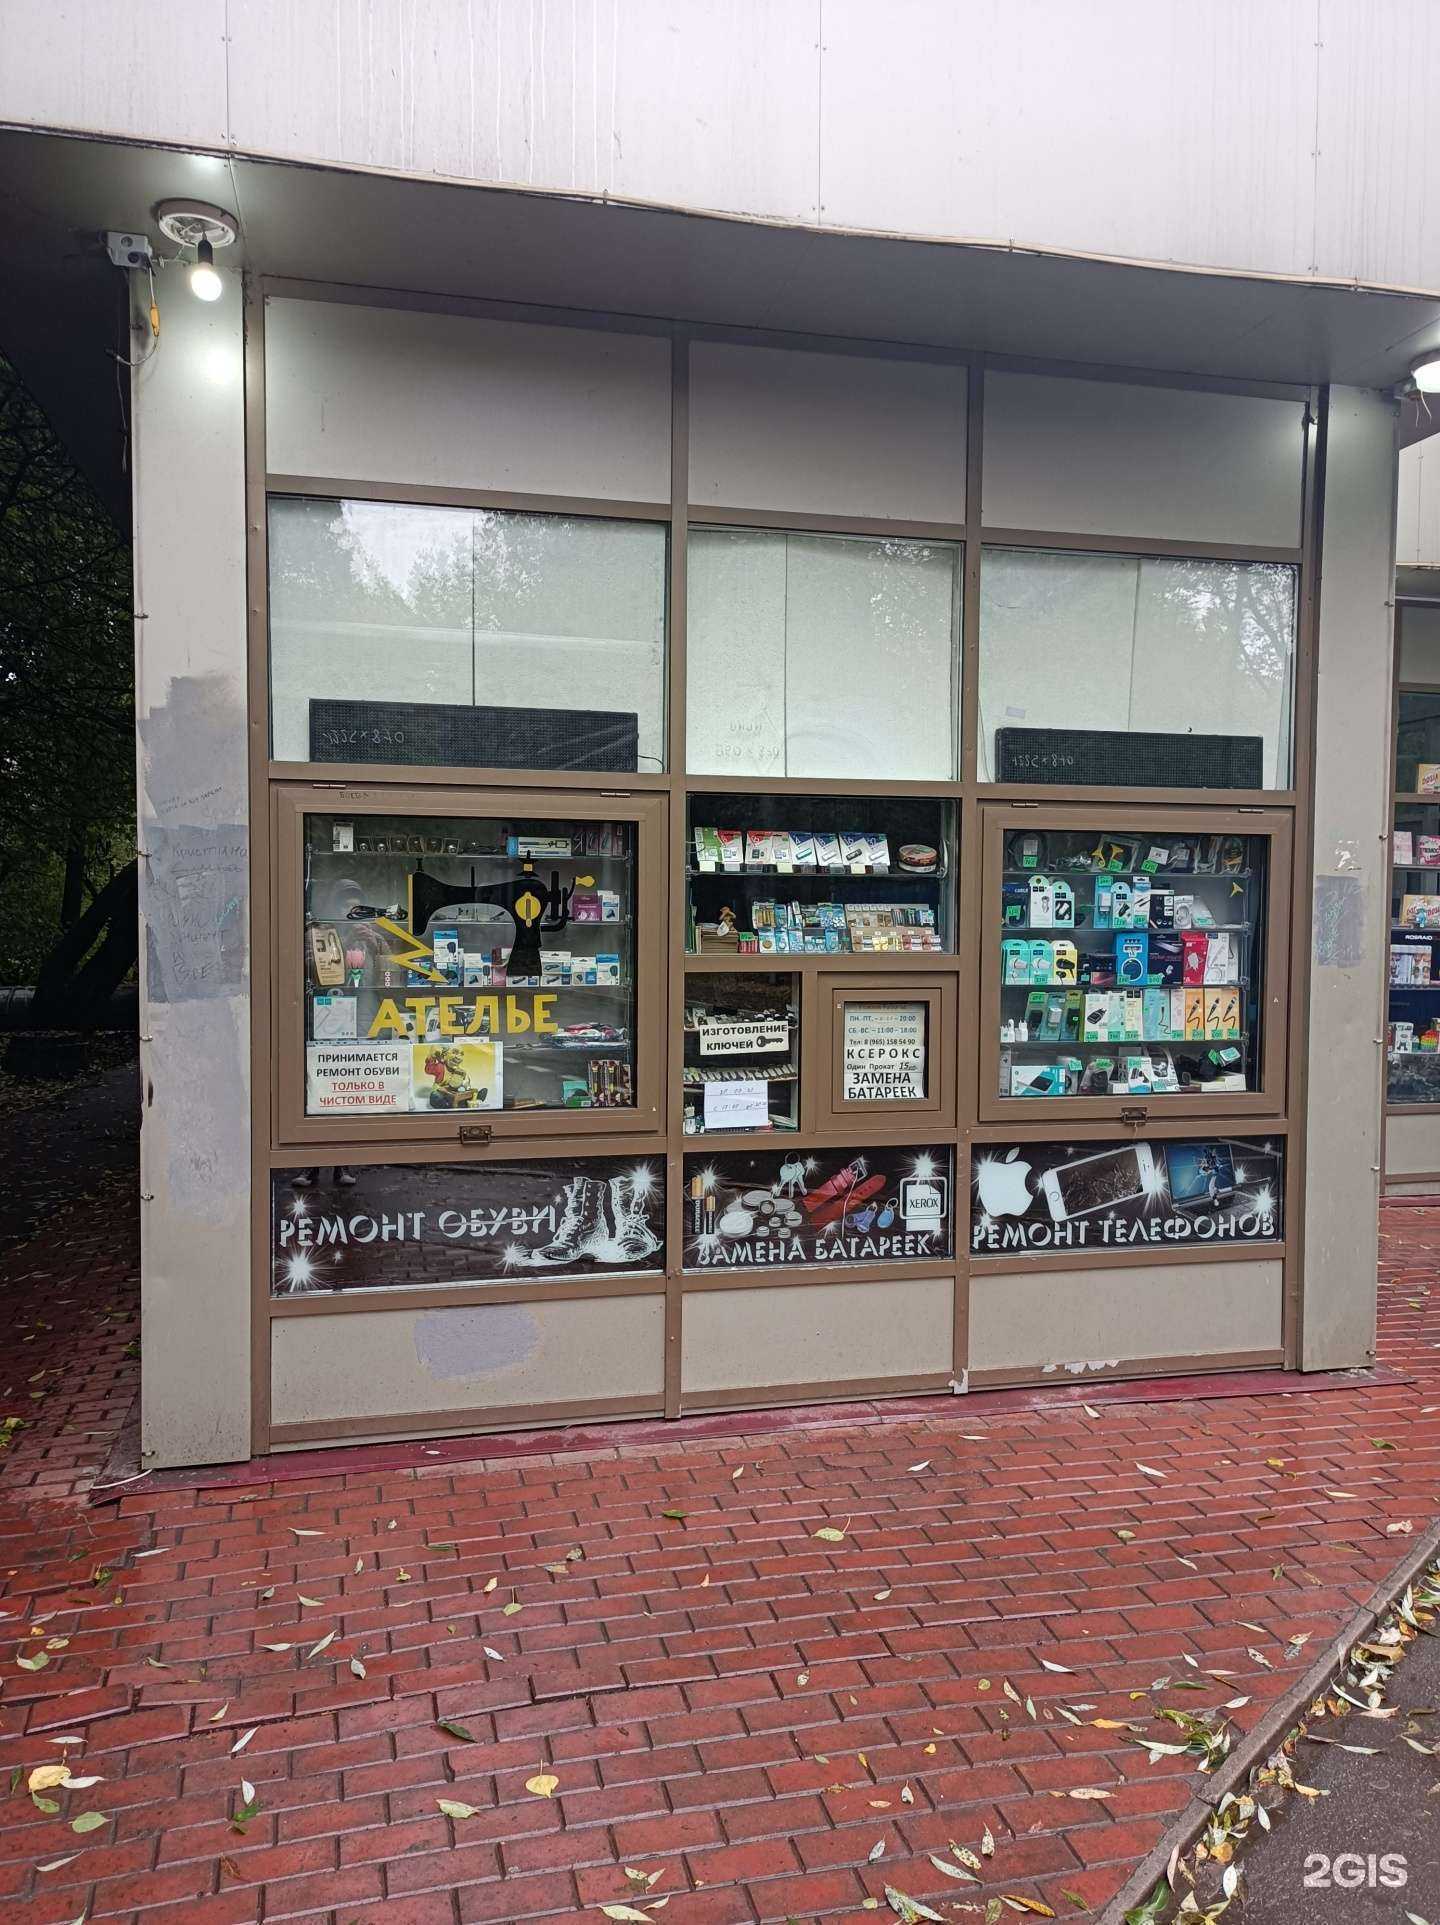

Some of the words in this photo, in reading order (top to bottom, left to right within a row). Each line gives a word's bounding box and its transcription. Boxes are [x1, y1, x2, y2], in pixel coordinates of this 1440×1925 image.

[367, 993, 559, 1038] АТЕЛЬЕ
[702, 1024, 788, 1037] ИЗГОТОВЛЕНИЕ
[706, 1040, 754, 1051] КЛЮЧЕЙ
[317, 1052, 399, 1064] ПРИНИМАЕТСЯ
[316, 1067, 362, 1078] РЕМОНТ
[364, 1065, 400, 1077] ОБУВИ
[853, 1073, 911, 1084] ЗАМЕНА
[331, 1080, 375, 1092] ТОЛЬКО
[377, 1080, 385, 1091] В
[848, 1086, 917, 1098] БАТАРЕЕК
[319, 1095, 366, 1106] ЧИСТОМ
[368, 1094, 397, 1105] ВИДЕ
[908, 1198, 939, 1210] XEROX
[279, 1213, 425, 1248] РЕМОНТ
[438, 1205, 556, 1239] ОБУВИ
[972, 1219, 1090, 1249] РЕМОНТ
[1097, 1214, 1276, 1243] ТЕЛЕФОНОВ
[698, 1237, 806, 1265] ЗАМЕНА
[815, 1233, 931, 1261] БАТАРЕЕК
